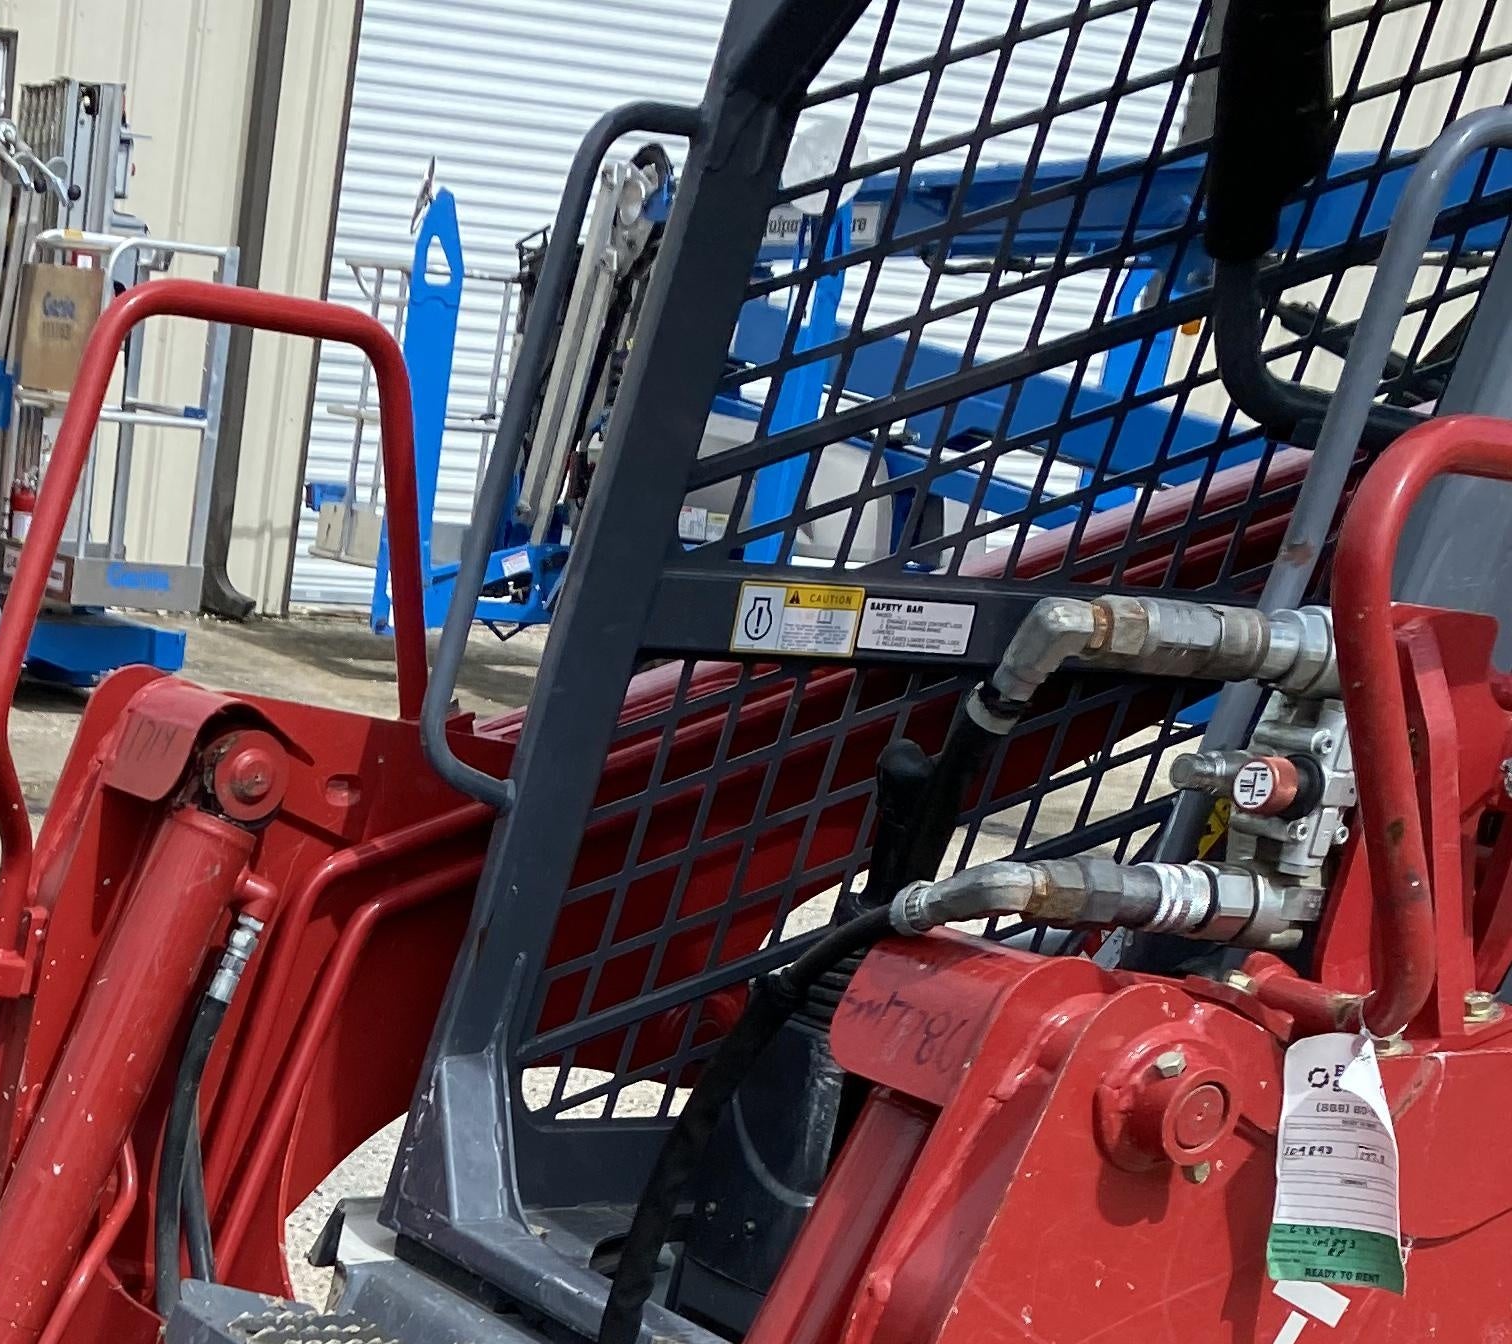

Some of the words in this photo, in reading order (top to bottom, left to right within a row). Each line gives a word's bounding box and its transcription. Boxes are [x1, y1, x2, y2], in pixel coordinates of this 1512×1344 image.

[809, 593, 854, 605] CAUTION
[870, 601, 903, 613] SAFETY
[1304, 1267, 1337, 1279] READY
[1340, 1270, 1354, 1281] TO
[1355, 1272, 1380, 1283] RENT
